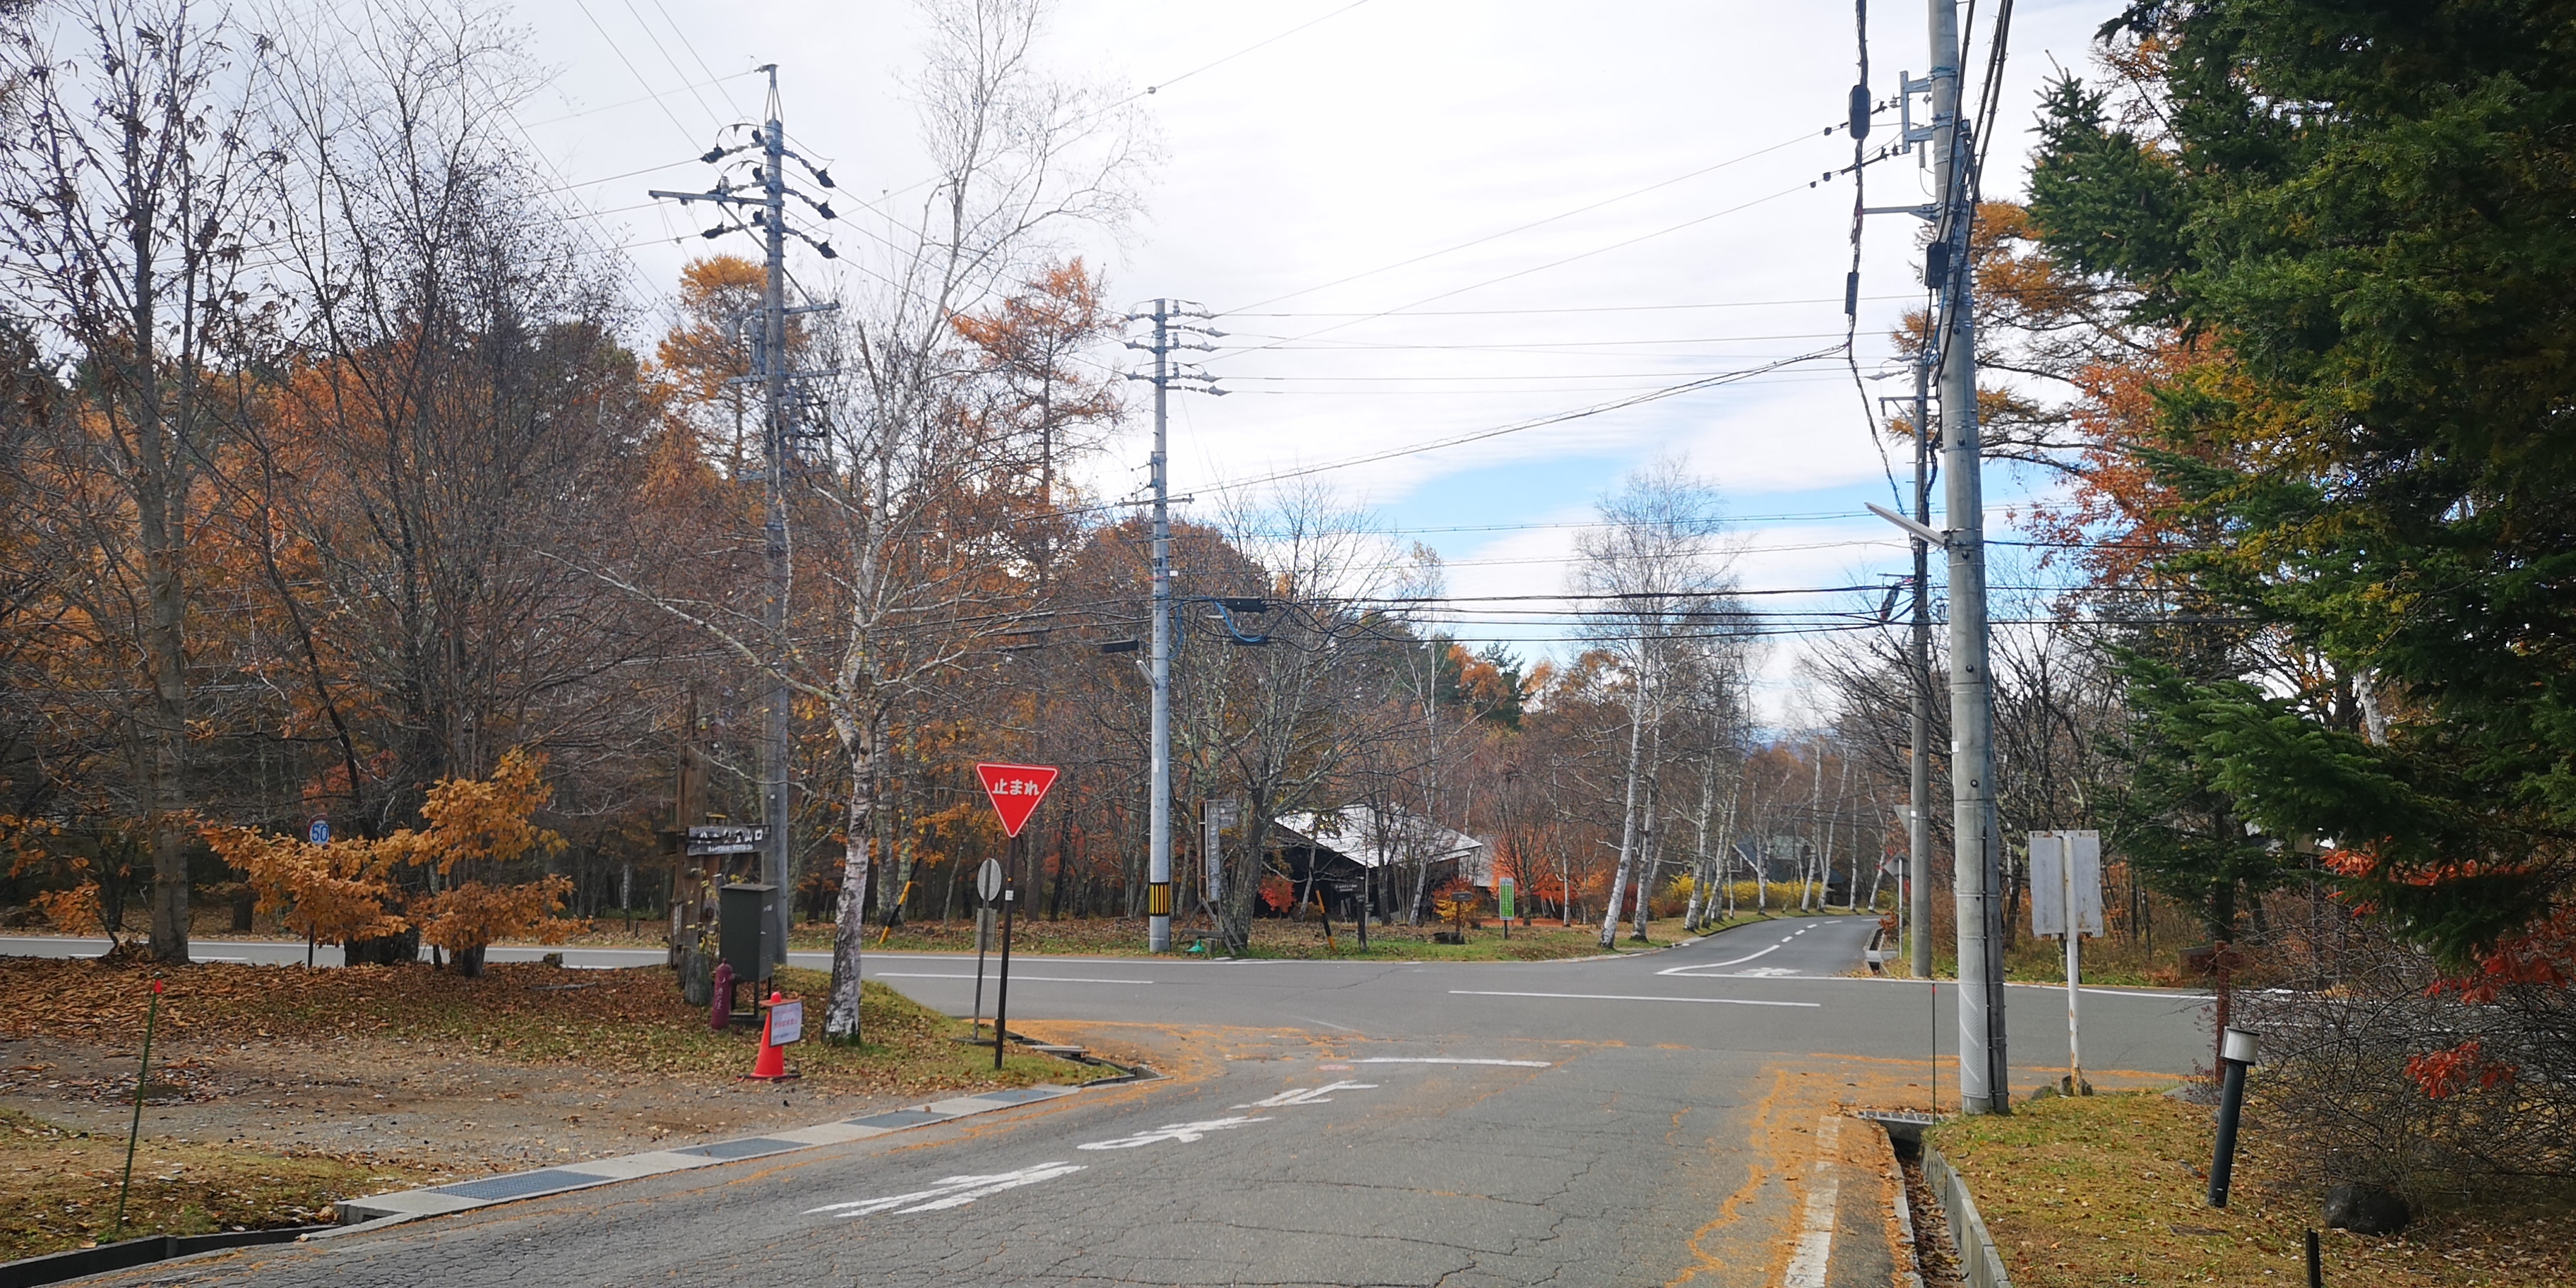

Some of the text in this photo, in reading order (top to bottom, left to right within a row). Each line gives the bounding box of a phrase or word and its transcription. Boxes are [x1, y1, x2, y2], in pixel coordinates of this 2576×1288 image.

[992, 777, 1040, 796] 止まれ
[311, 825, 328, 842] 50
